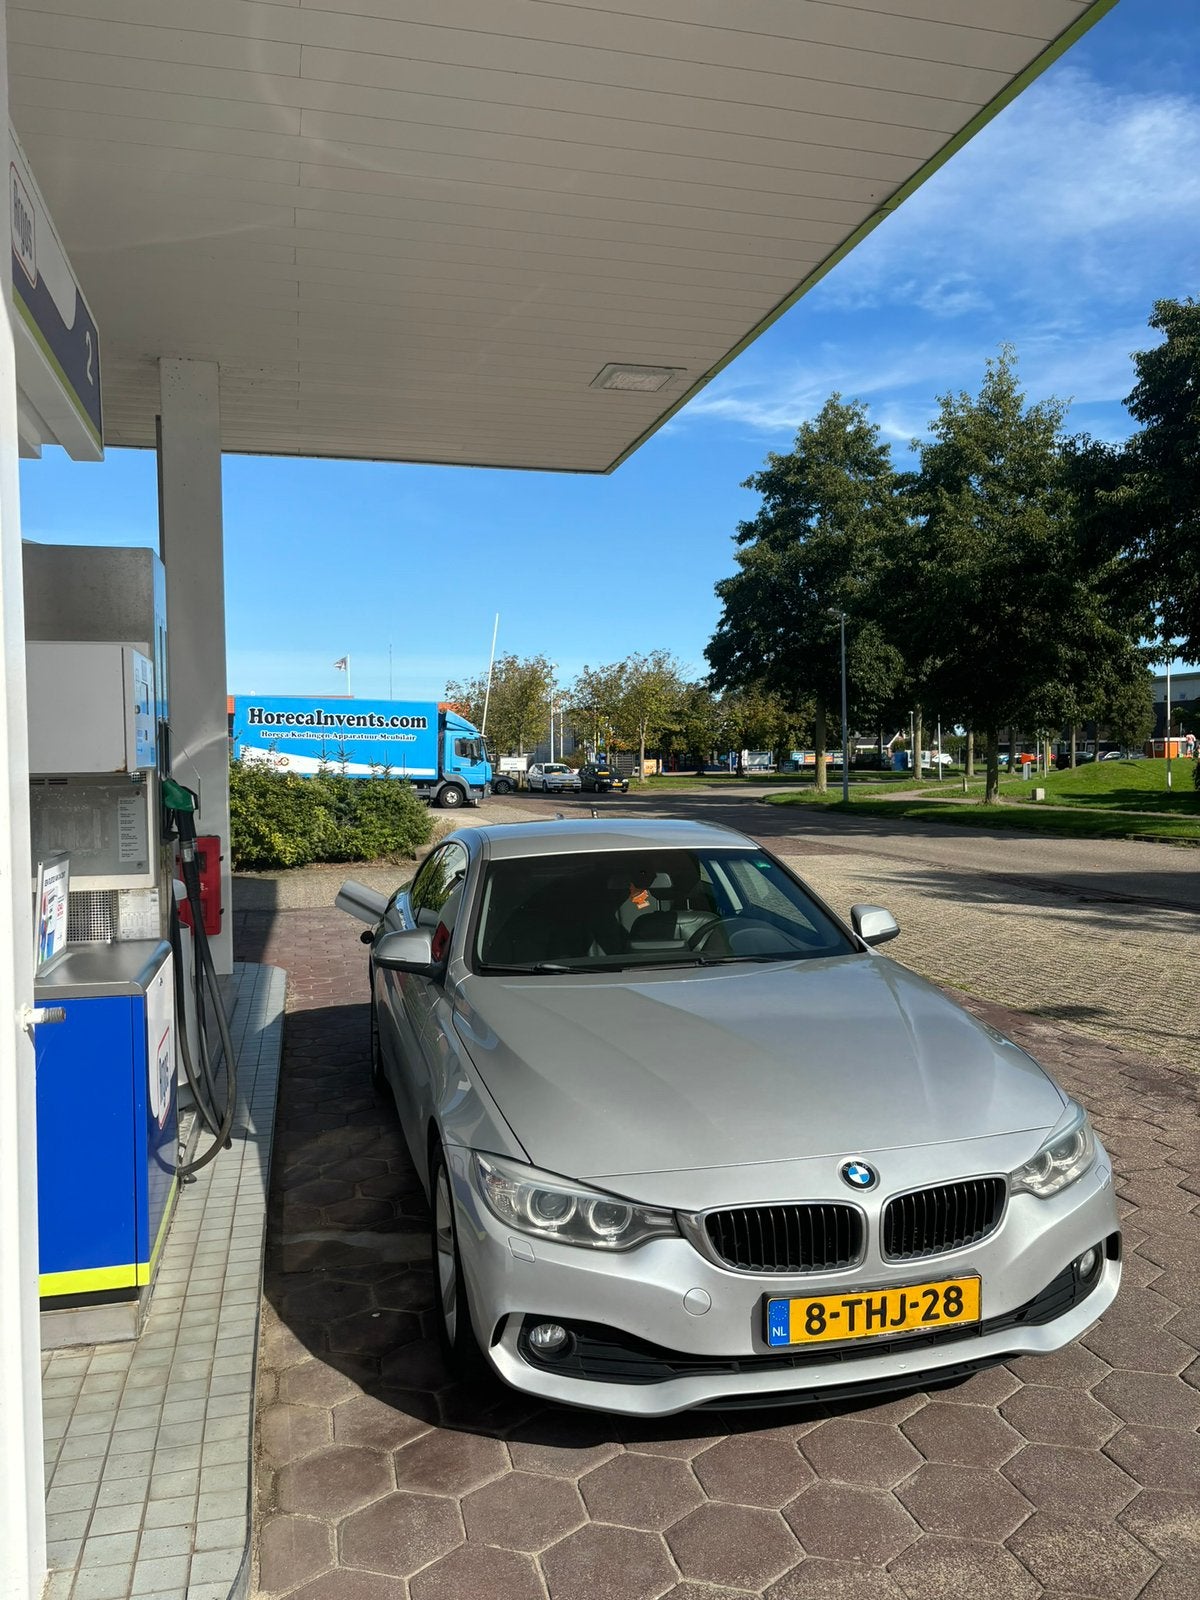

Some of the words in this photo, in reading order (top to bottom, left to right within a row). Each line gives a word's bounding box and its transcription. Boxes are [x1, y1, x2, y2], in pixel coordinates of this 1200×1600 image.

[85, 330, 94, 386] 2
[249, 708, 427, 729] HorecaInvents.com
[804, 1285, 964, 1336] 8-THJ-28
[772, 1326, 787, 1337] NL
